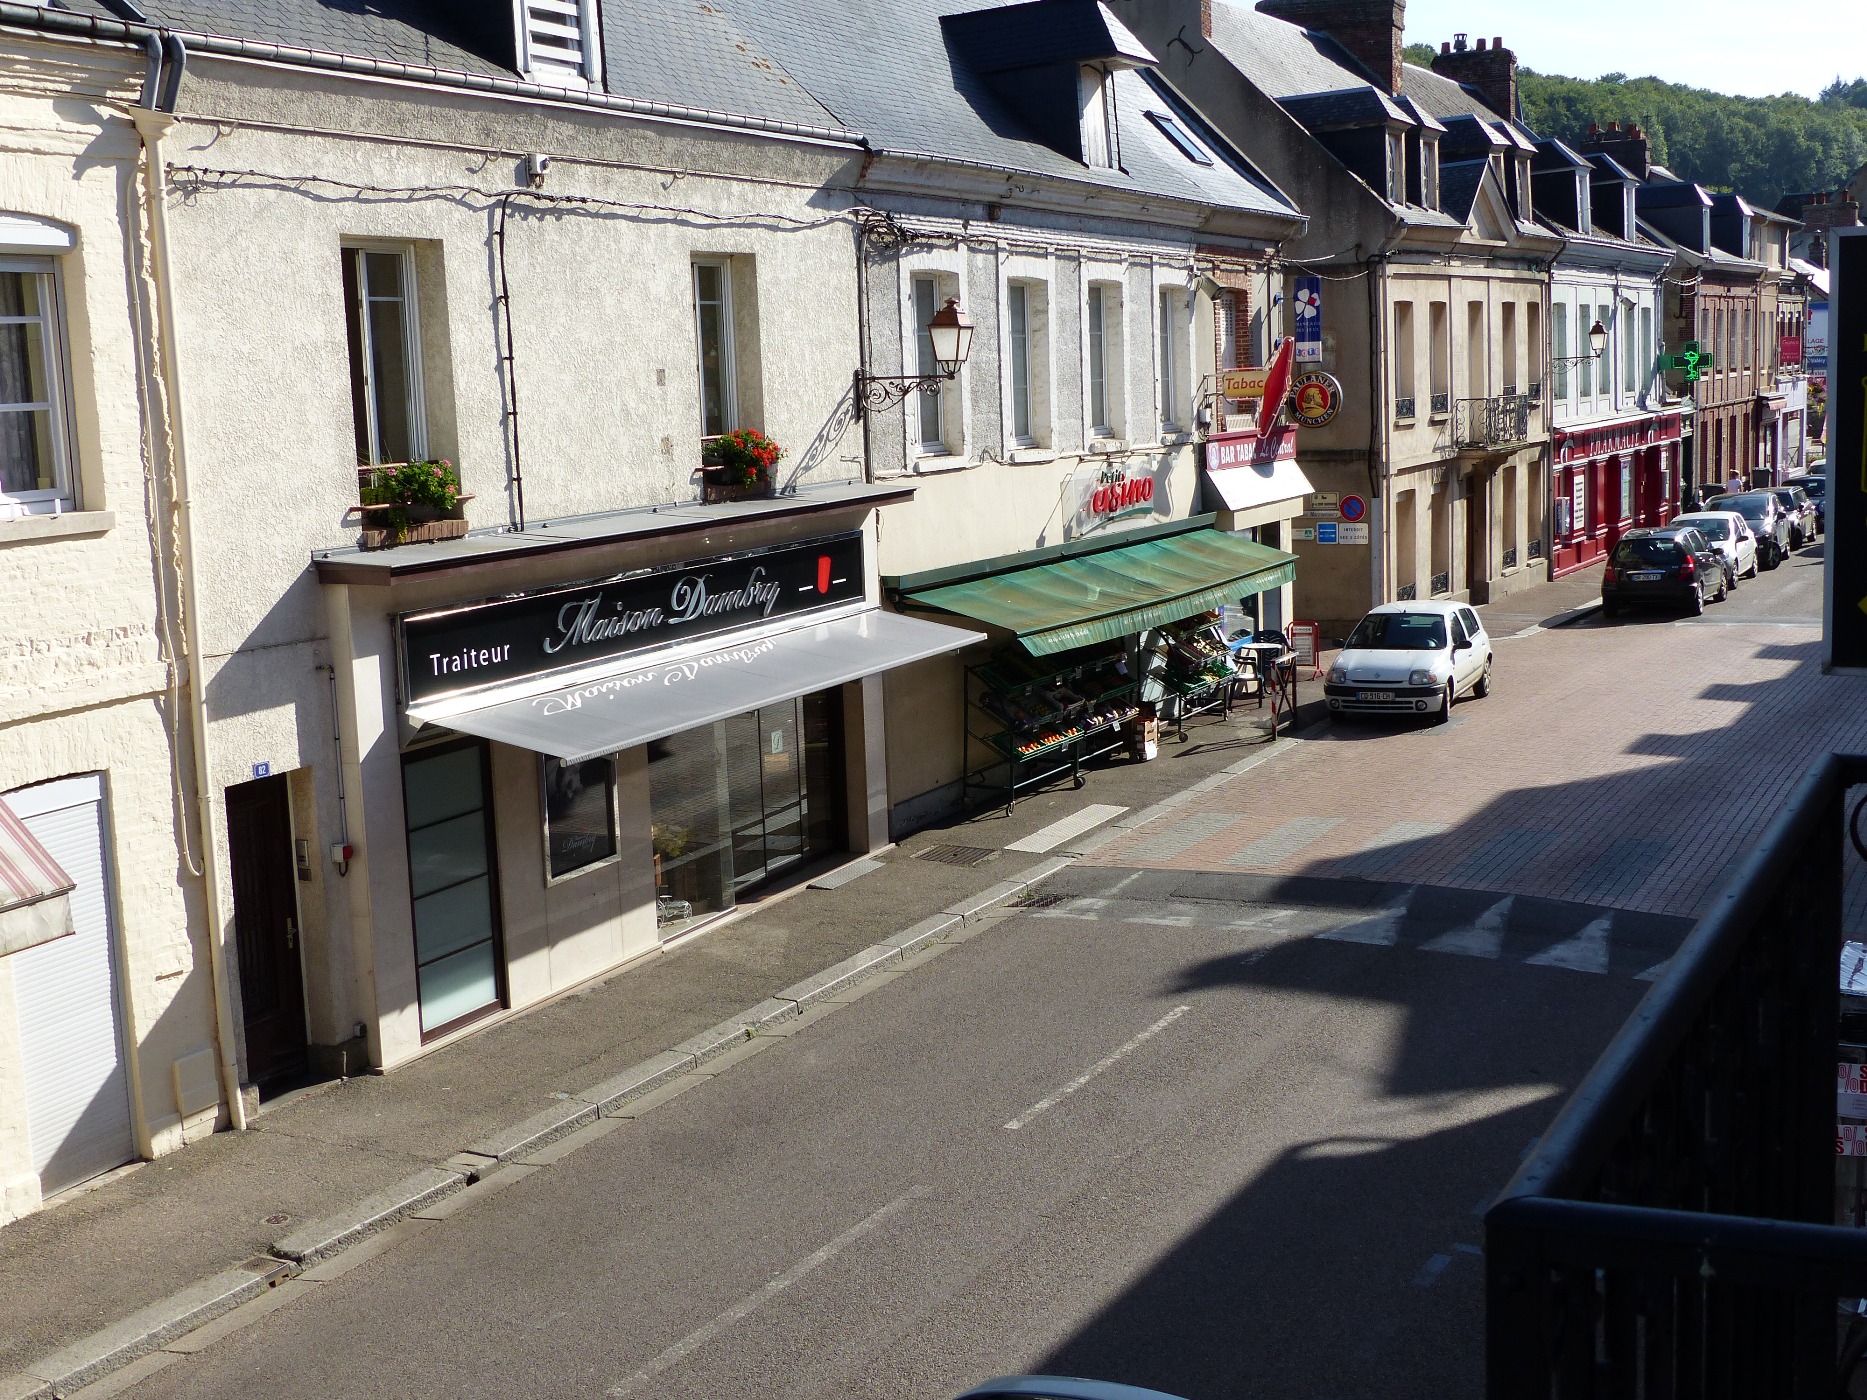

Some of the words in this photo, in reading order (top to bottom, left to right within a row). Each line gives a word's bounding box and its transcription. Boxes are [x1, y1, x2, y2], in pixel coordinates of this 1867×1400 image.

[1225, 377, 1264, 390] Tabac
[1290, 375, 1335, 398] PAULANER
[1220, 446, 1235, 464] BAR
[1236, 442, 1257, 461] TABAC
[1270, 436, 1294, 459] Central
[1589, 423, 1640, 457] PHARMACIE
[1100, 469, 1123, 484] Petit
[543, 591, 664, 654] Maison
[667, 567, 781, 625] Dambry
[429, 642, 511, 676] Traiteur
[258, 765, 266, 775] 82
